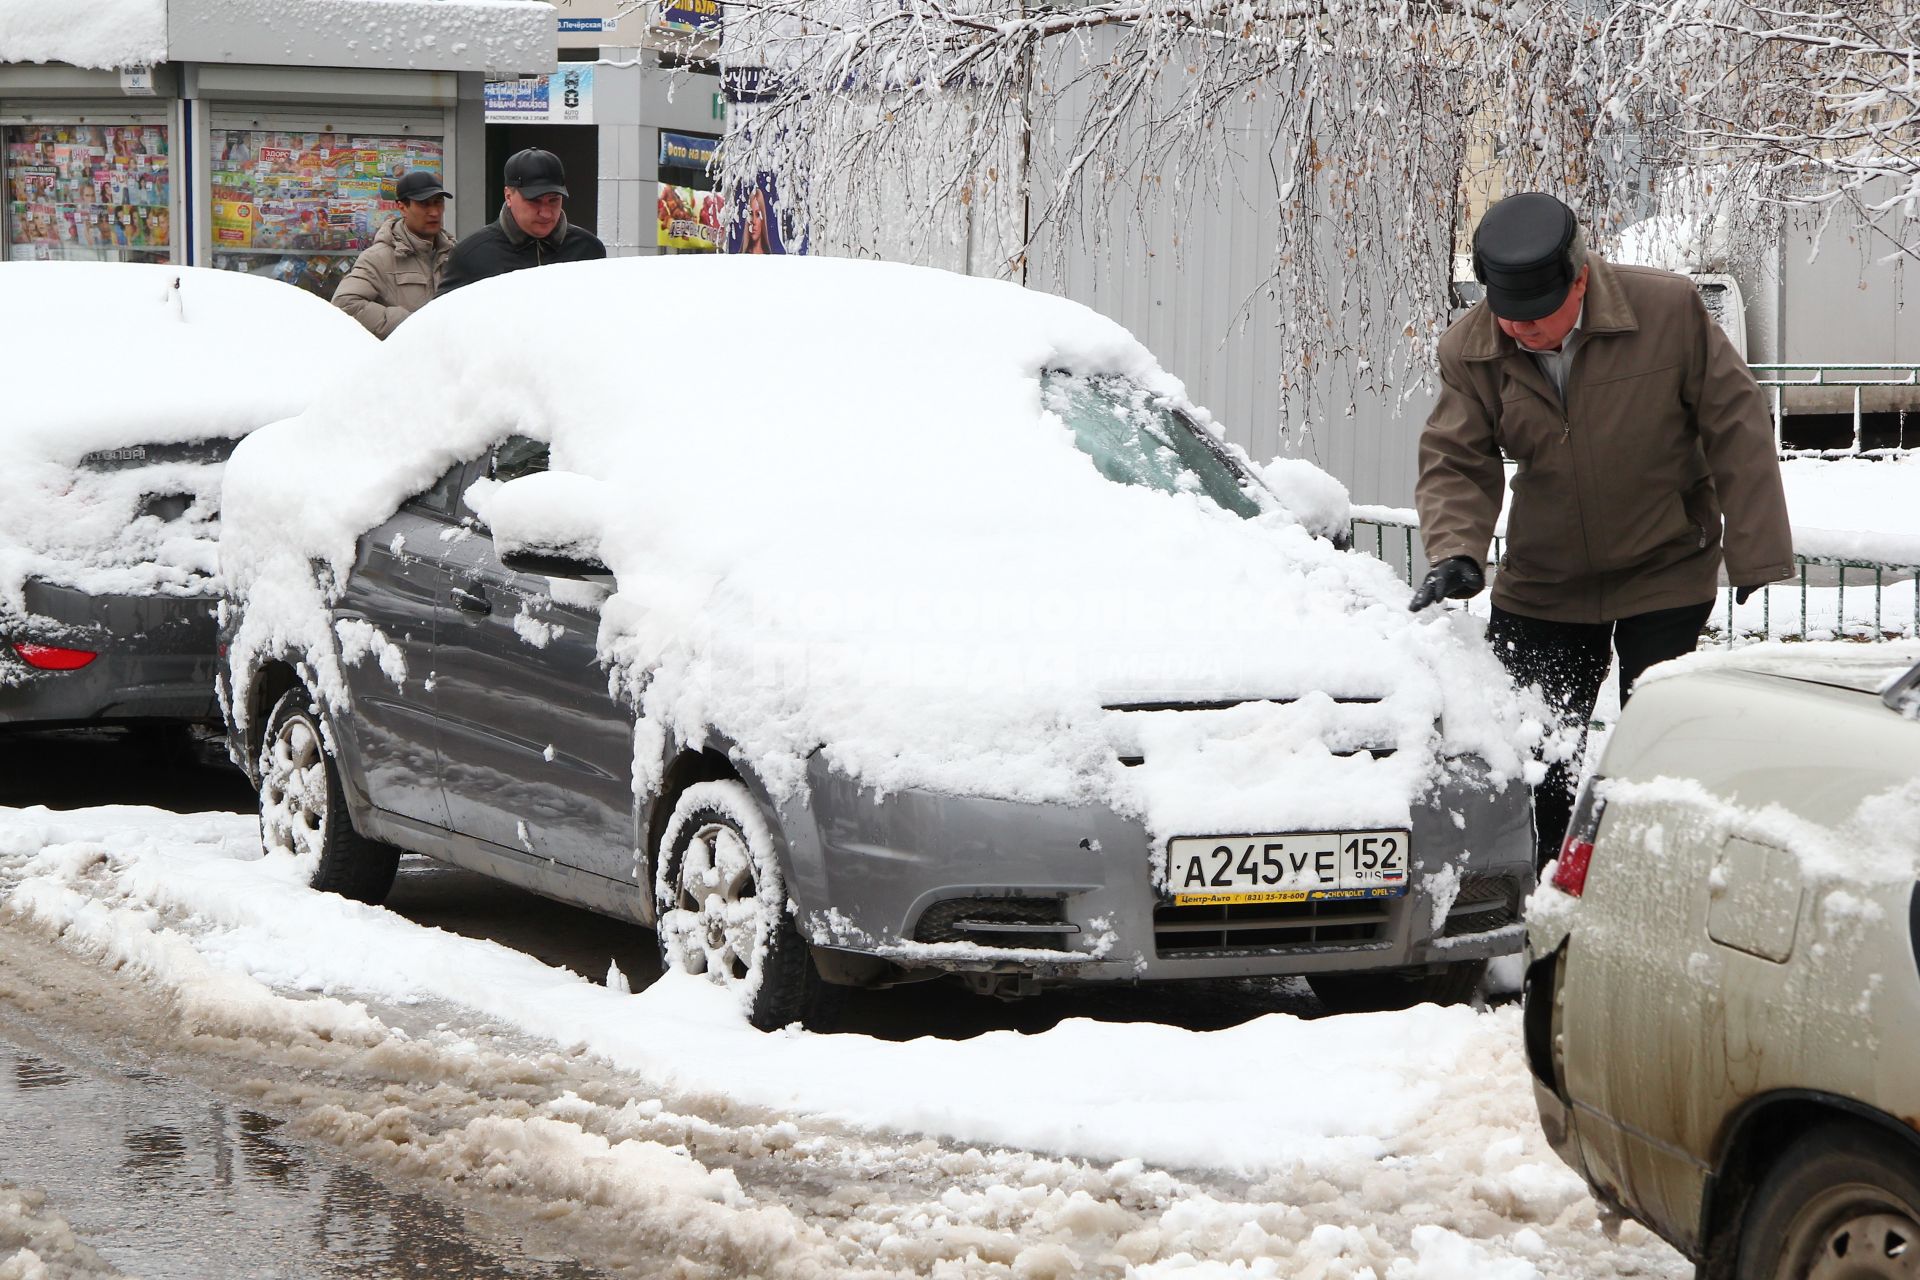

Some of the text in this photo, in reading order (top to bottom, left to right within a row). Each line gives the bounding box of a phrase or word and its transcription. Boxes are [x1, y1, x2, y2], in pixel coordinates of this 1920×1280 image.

[1344, 837, 1398, 870] 152
[1327, 888, 1389, 897] CHEVROLET OPEL
[1181, 894, 1231, 904] Центр-Авто
